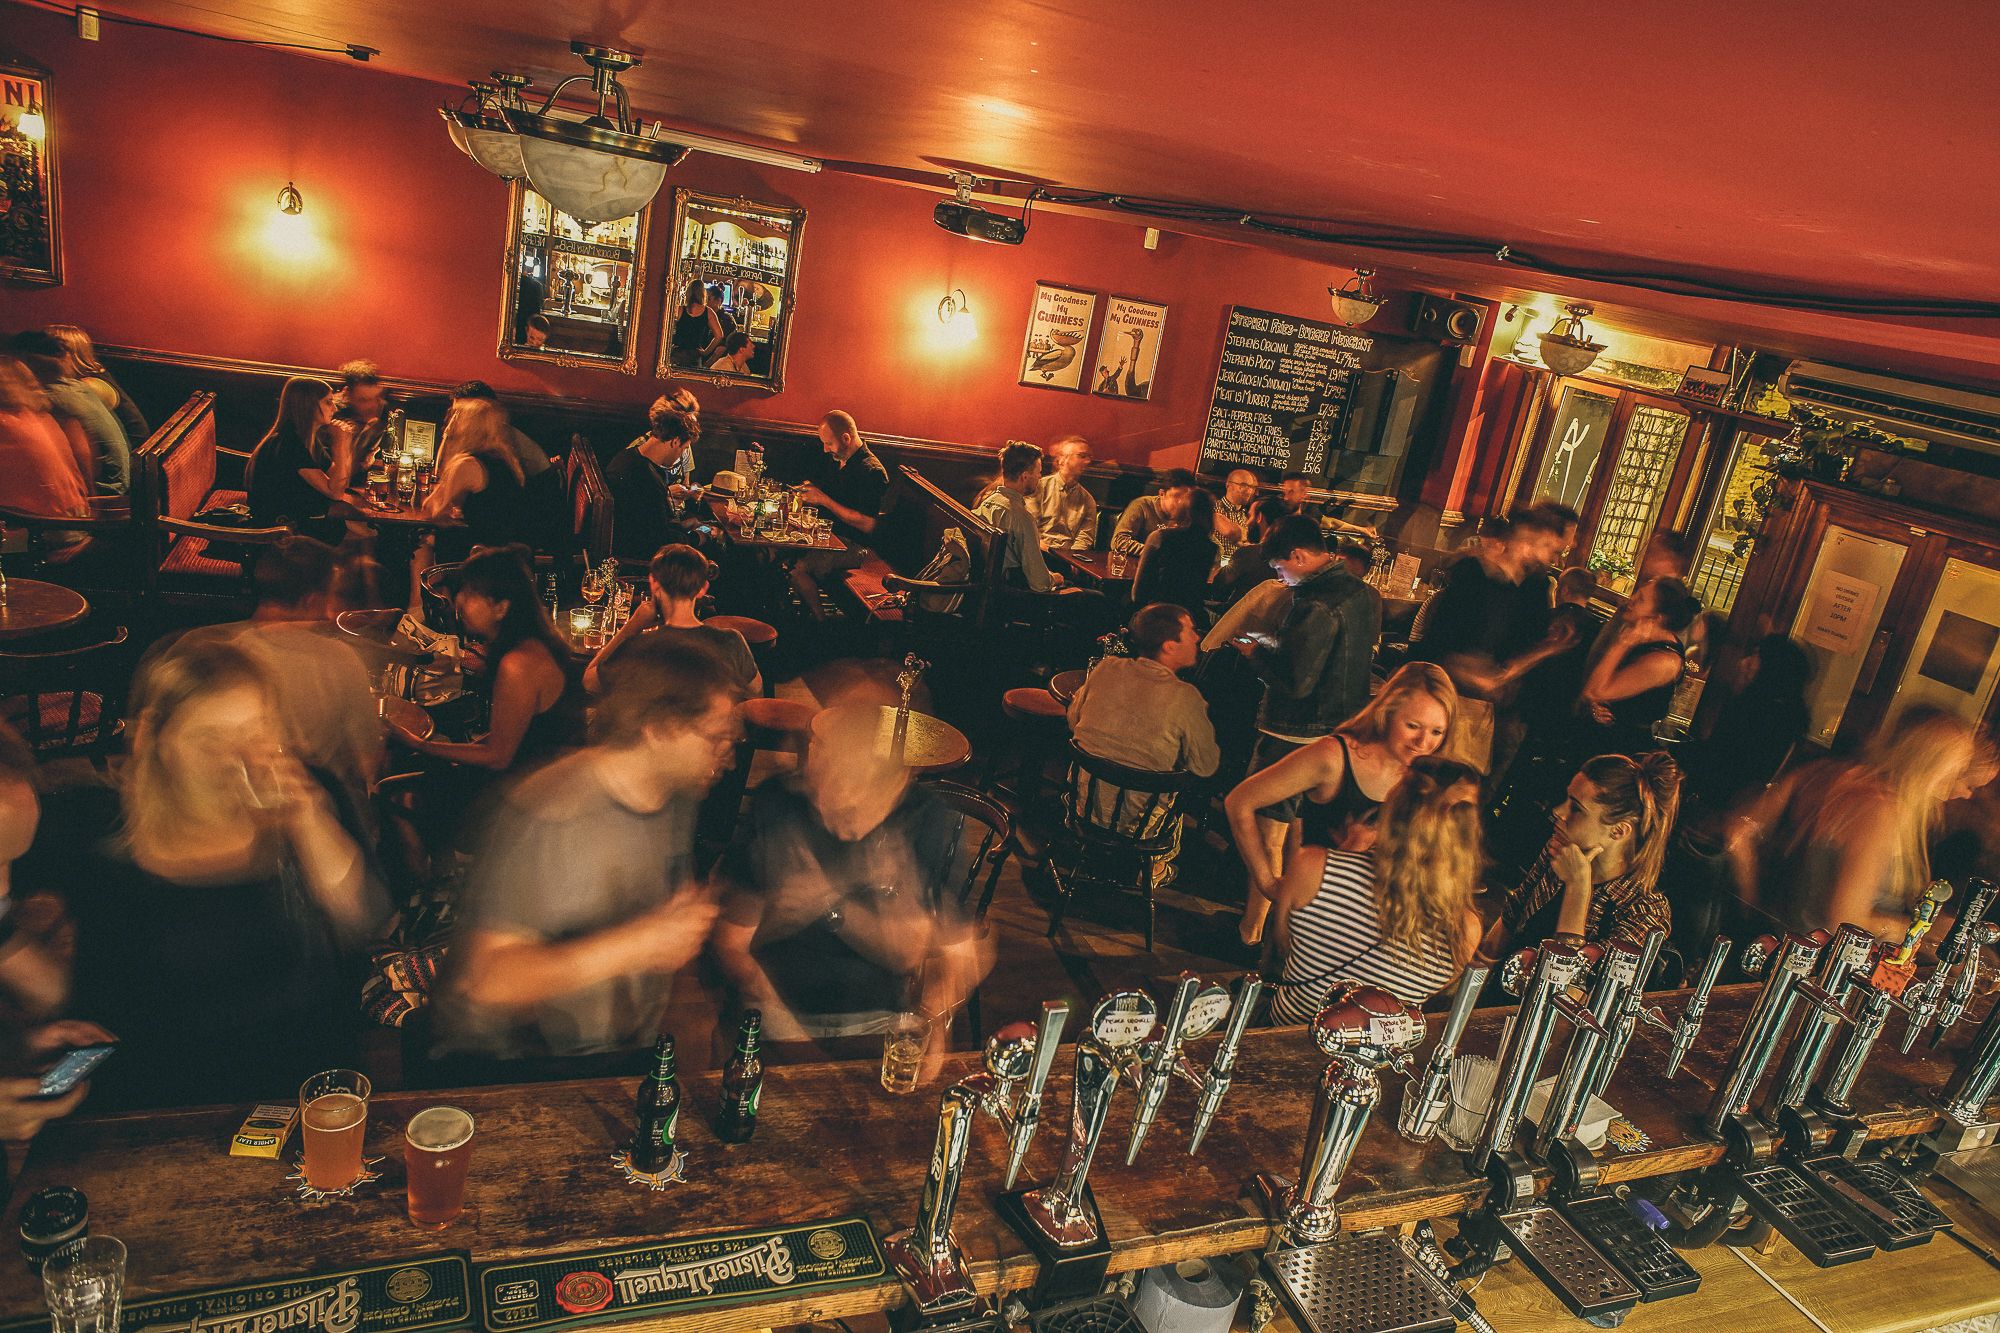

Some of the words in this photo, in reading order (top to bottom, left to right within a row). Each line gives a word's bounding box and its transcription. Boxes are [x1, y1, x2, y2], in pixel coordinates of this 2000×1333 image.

[1040, 291, 1052, 302] My
[1053, 293, 1088, 306] Goodness
[1056, 304, 1068, 315] My
[1116, 303, 1127, 314] My
[1128, 305, 1158, 318] Goodness
[1037, 310, 1085, 327] GUINNESS
[1110, 312, 1121, 324] My
[1122, 313, 1160, 329] GUINNESS
[1833, 602, 1852, 613] AFTER
[1829, 612, 1847, 623] 10PM
[253, 1138, 275, 1146] AMBER
[707, 1235, 795, 1285] Pilsner
